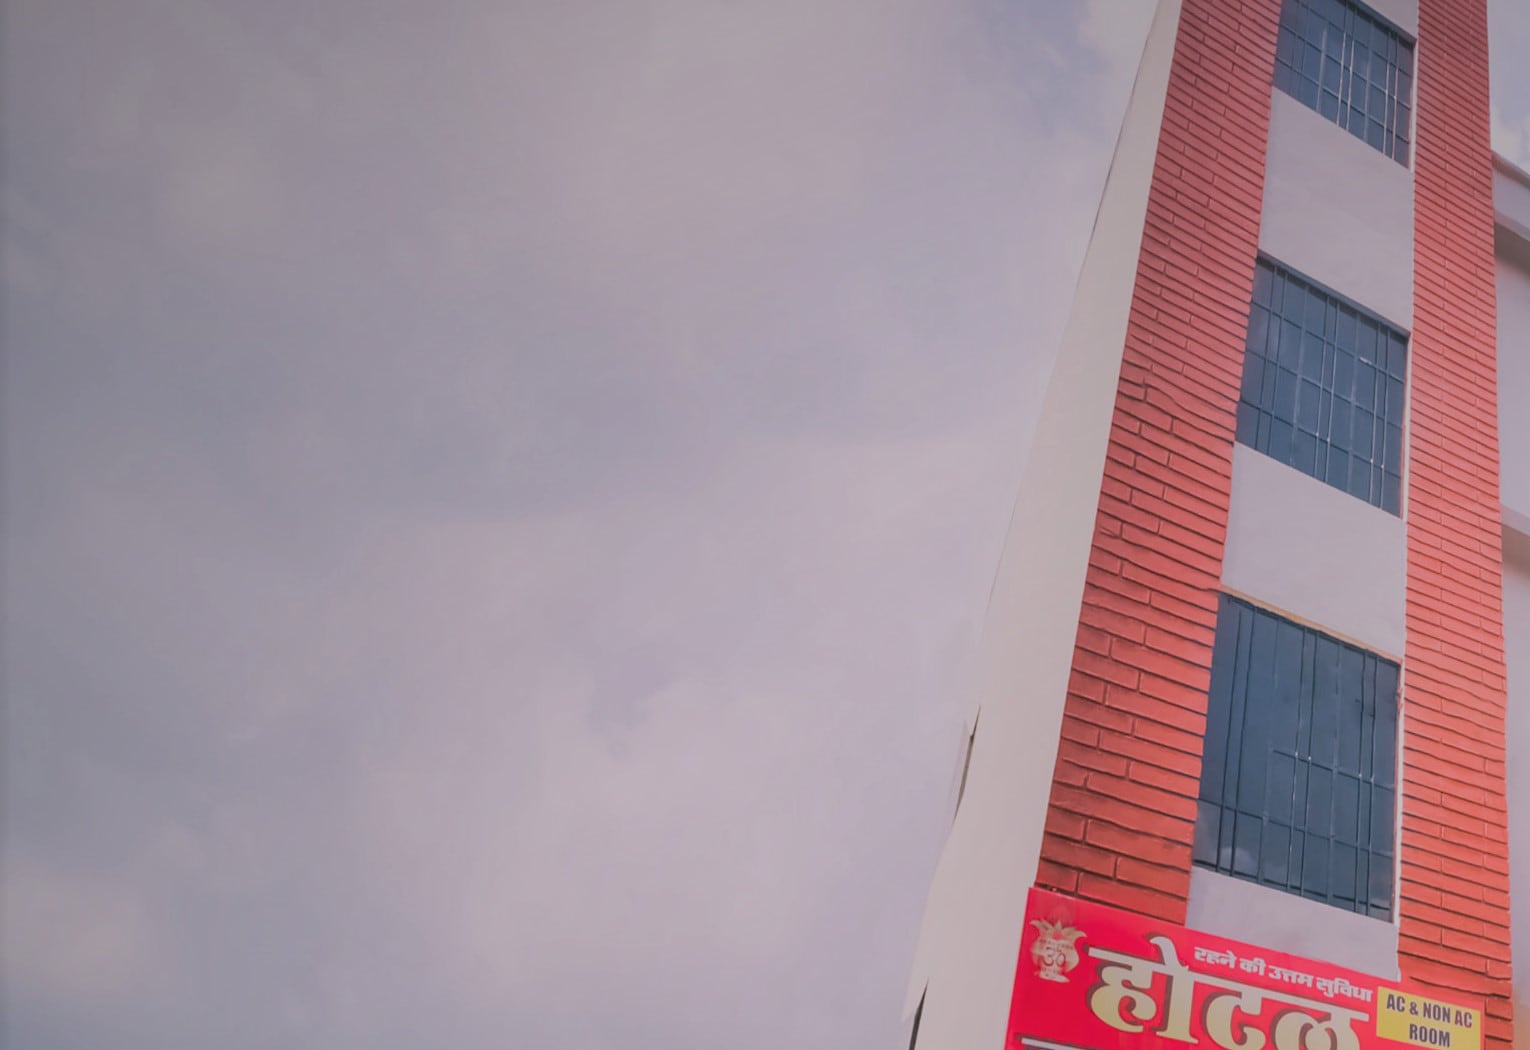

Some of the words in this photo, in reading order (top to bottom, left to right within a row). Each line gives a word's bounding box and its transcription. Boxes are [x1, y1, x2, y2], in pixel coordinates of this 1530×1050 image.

[1193, 946, 1237, 969] रहने
[1239, 957, 1266, 977] की
[1268, 964, 1314, 988] उत्तम
[1316, 976, 1373, 1003] सुविधा
[1386, 993, 1406, 1013] AC
[1409, 1000, 1419, 1016] &
[1422, 1001, 1451, 1024] NON
[1454, 1008, 1473, 1029] AC
[1408, 1023, 1451, 1048] ROOM
